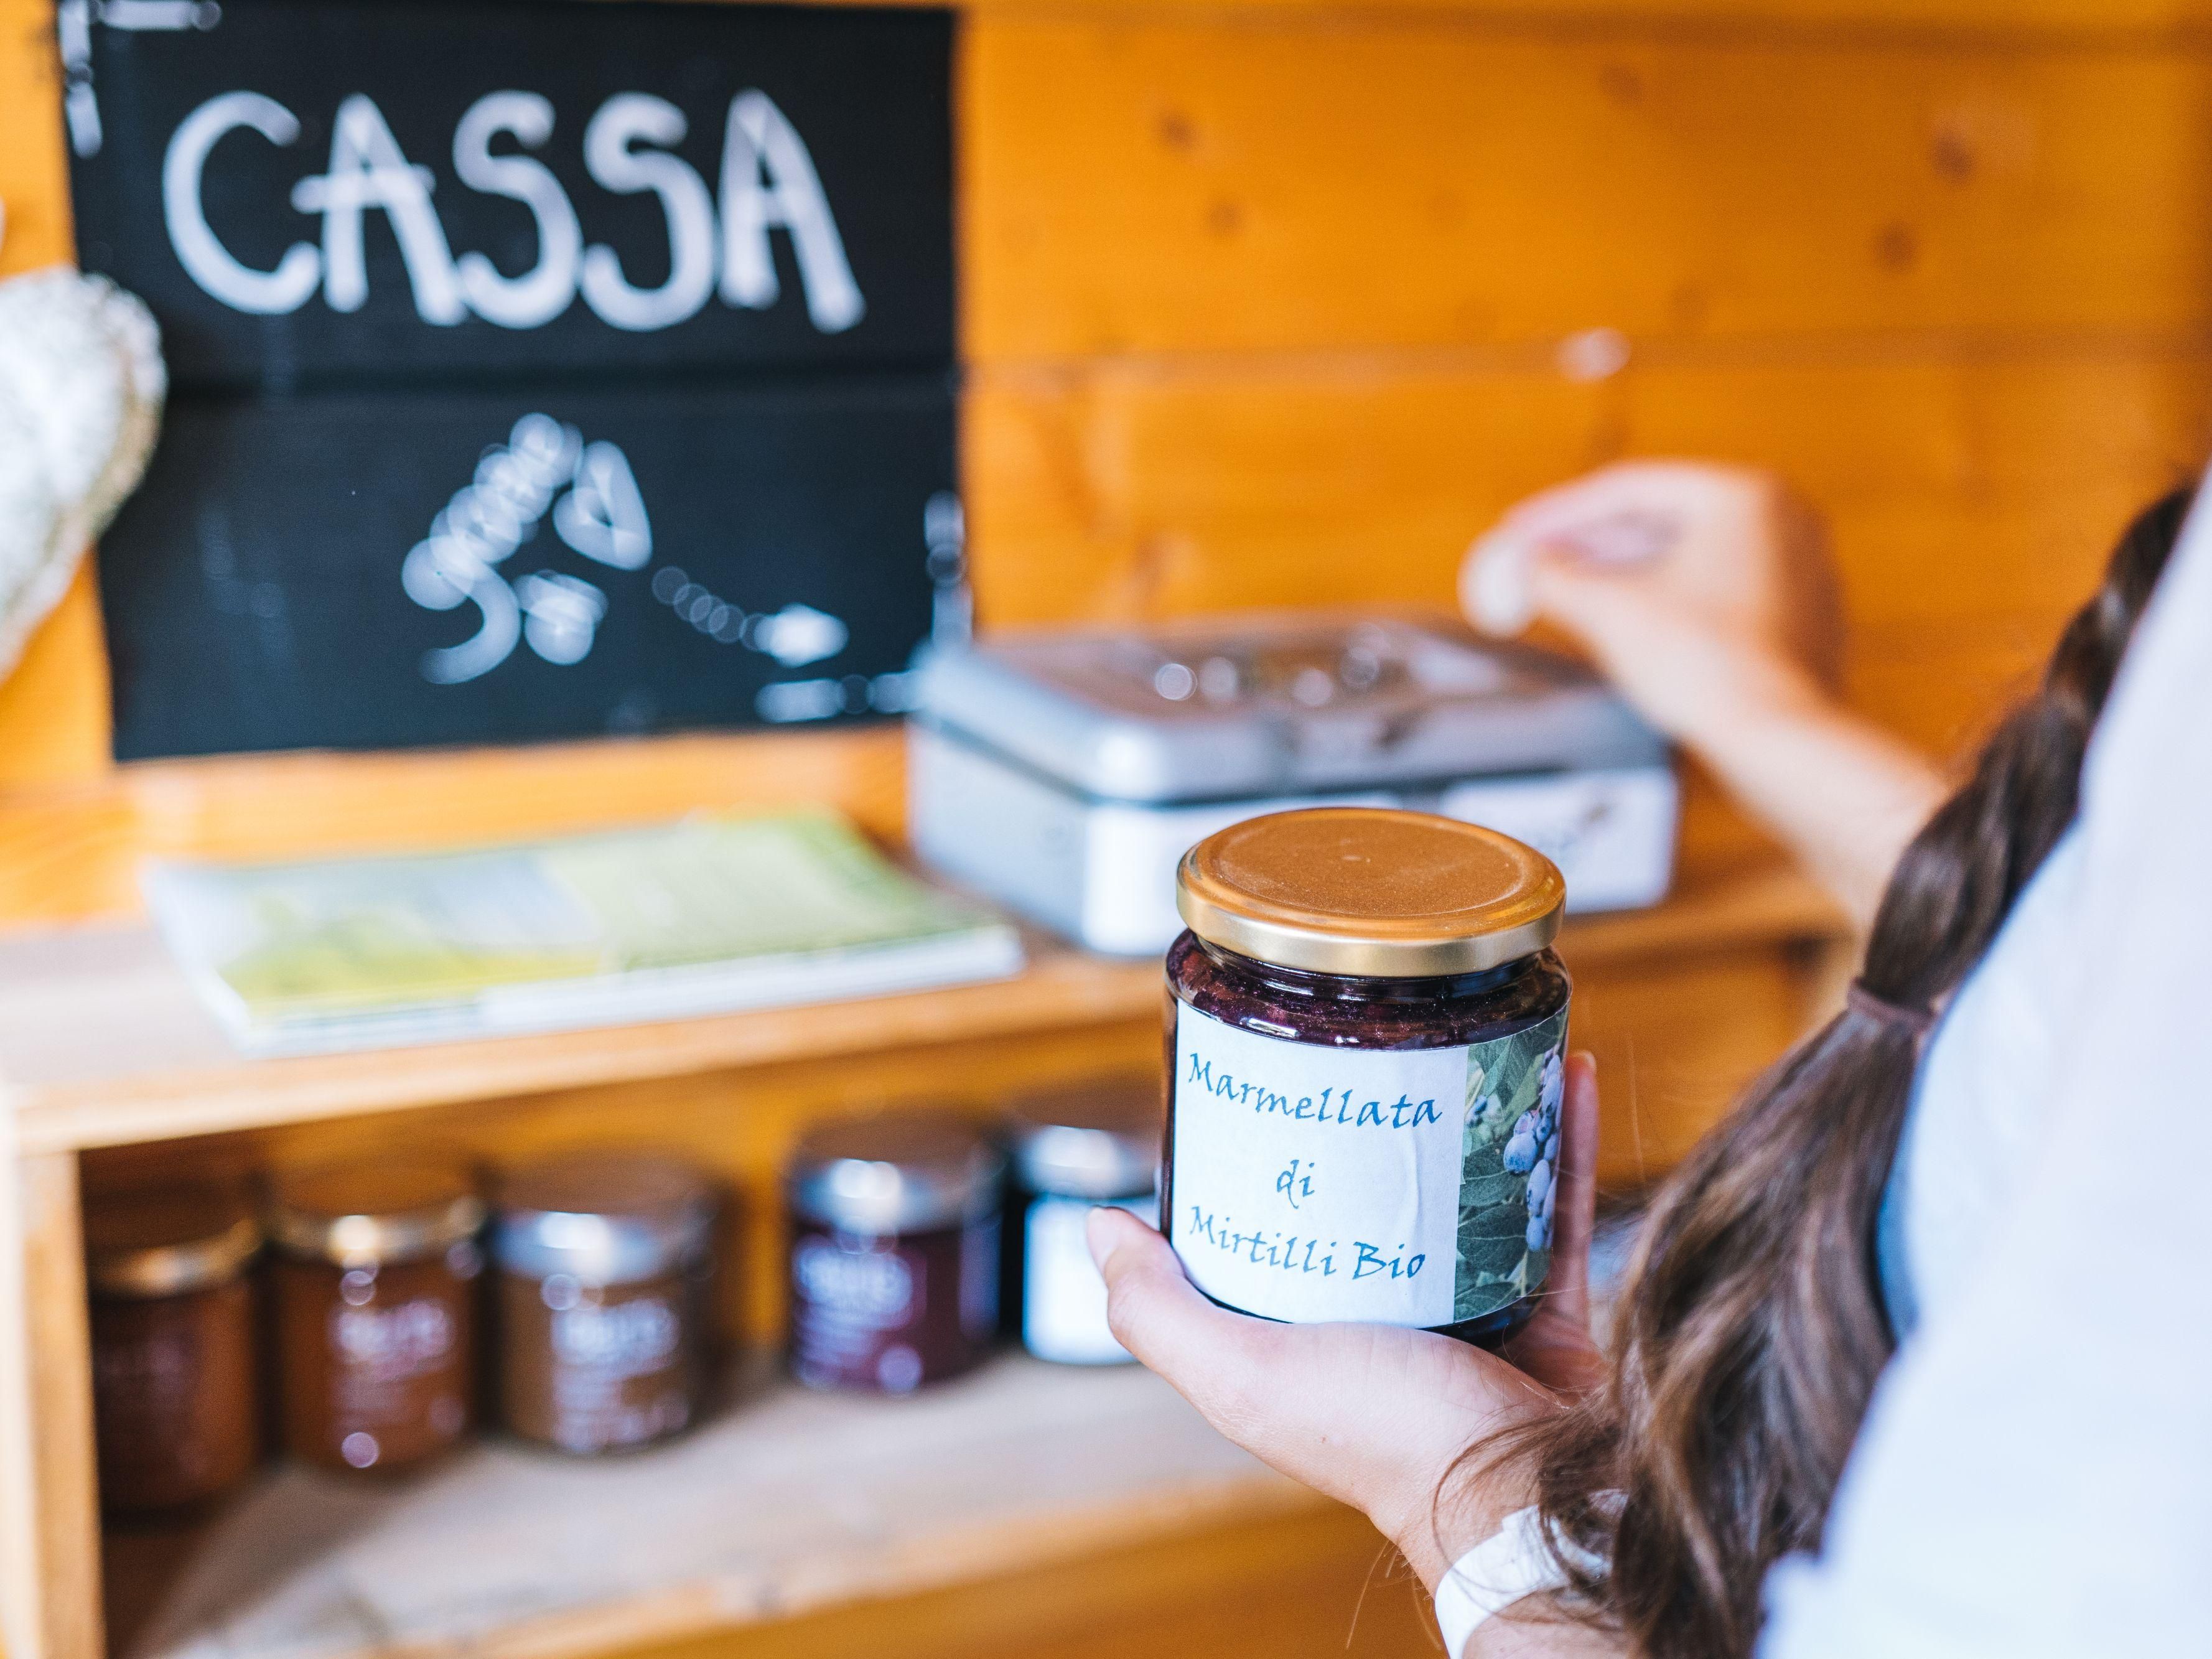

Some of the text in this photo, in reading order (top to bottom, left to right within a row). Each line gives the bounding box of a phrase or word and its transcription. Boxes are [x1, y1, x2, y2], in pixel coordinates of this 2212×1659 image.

[163, 88, 866, 332] CASSA
[1188, 1052, 1443, 1129] Marmellata
[1276, 1159, 1315, 1208] di
[1189, 1206, 1426, 1280] Mirtilli Bio
